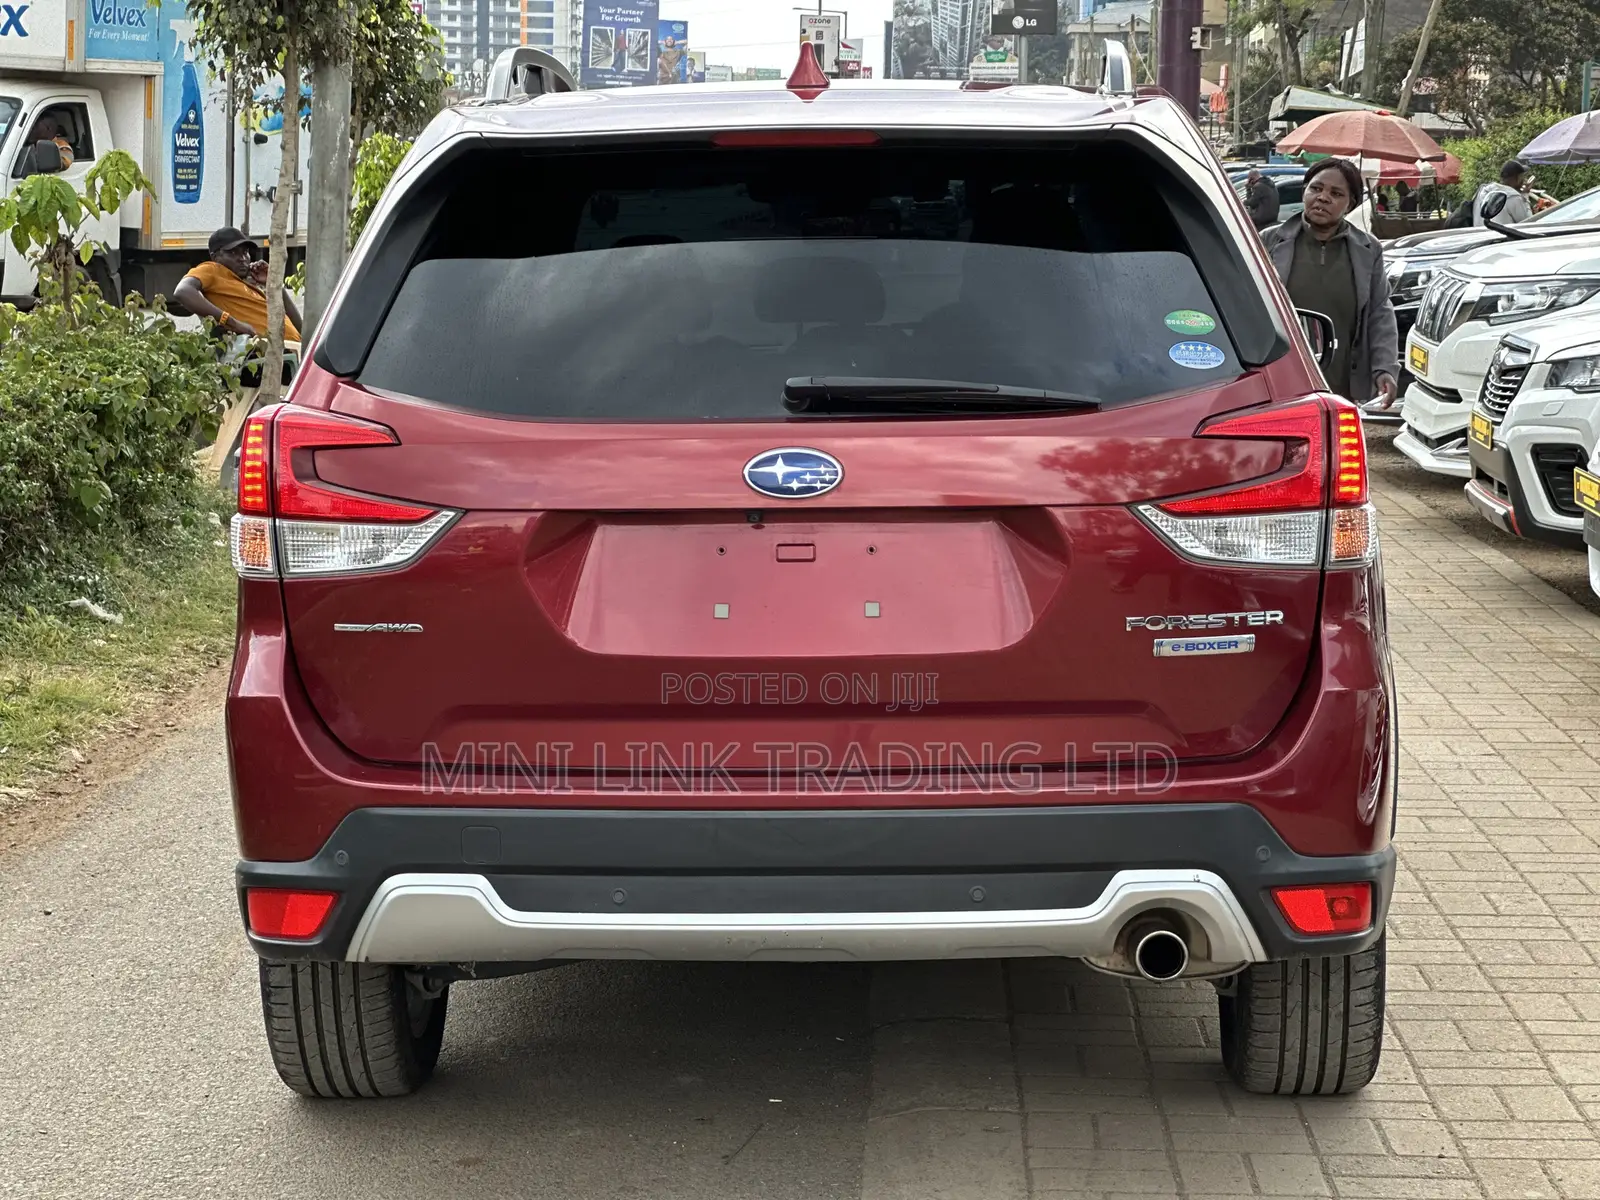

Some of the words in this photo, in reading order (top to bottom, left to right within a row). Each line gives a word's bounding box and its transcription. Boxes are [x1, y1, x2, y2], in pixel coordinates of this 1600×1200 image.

[90, 0, 147, 28] Velvex
[599, 6, 616, 14] Your
[616, 7, 645, 16] Partner
[614, 14, 641, 23] Growth
[1025, 18, 1037, 26] LG
[88, 28, 101, 39] For
[101, 29, 121, 42] Every
[175, 132, 201, 147] Velvex
[1125, 610, 1284, 632] FORESTER
[366, 623, 424, 632] AWD
[1171, 640, 1239, 652] e-BOXER
